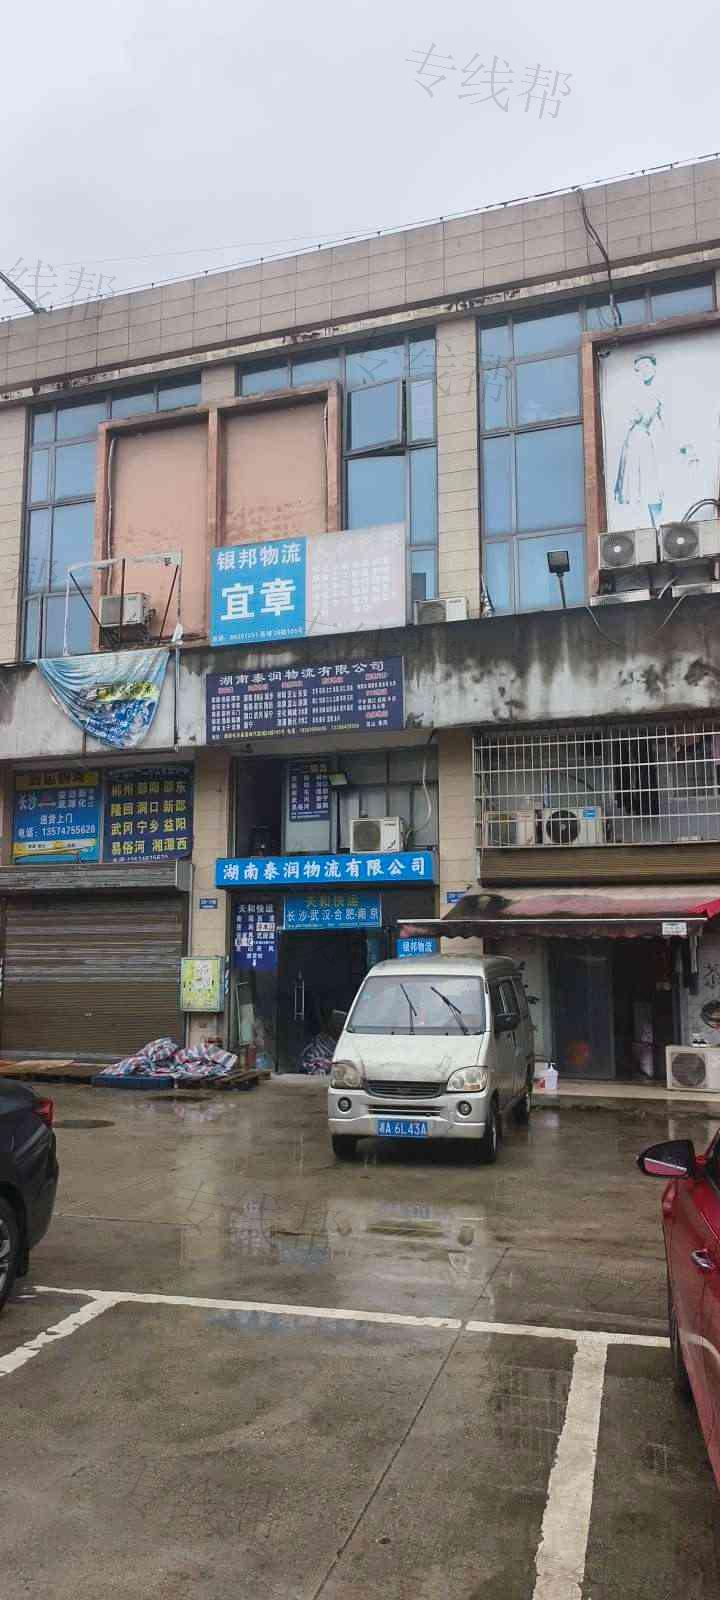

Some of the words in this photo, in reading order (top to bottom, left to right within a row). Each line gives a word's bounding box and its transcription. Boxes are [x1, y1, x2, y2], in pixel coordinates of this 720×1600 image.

[216, 543, 302, 571] 银邦物流
[220, 577, 297, 621] 宜章
[219, 660, 385, 686] 湖南泰润物流有限公司
[40, 813, 73, 825] 送货上门
[110, 803, 134, 816] 隆回
[136, 801, 159, 815] 洞口
[111, 822, 134, 836] 武冈
[136, 819, 159, 834] 宁乡
[163, 817, 186, 832] 益阳
[111, 840, 145, 855] 易俗河
[152, 836, 189, 852] 湘潭西
[223, 857, 426, 881] 湖南泰润物流有限公司
